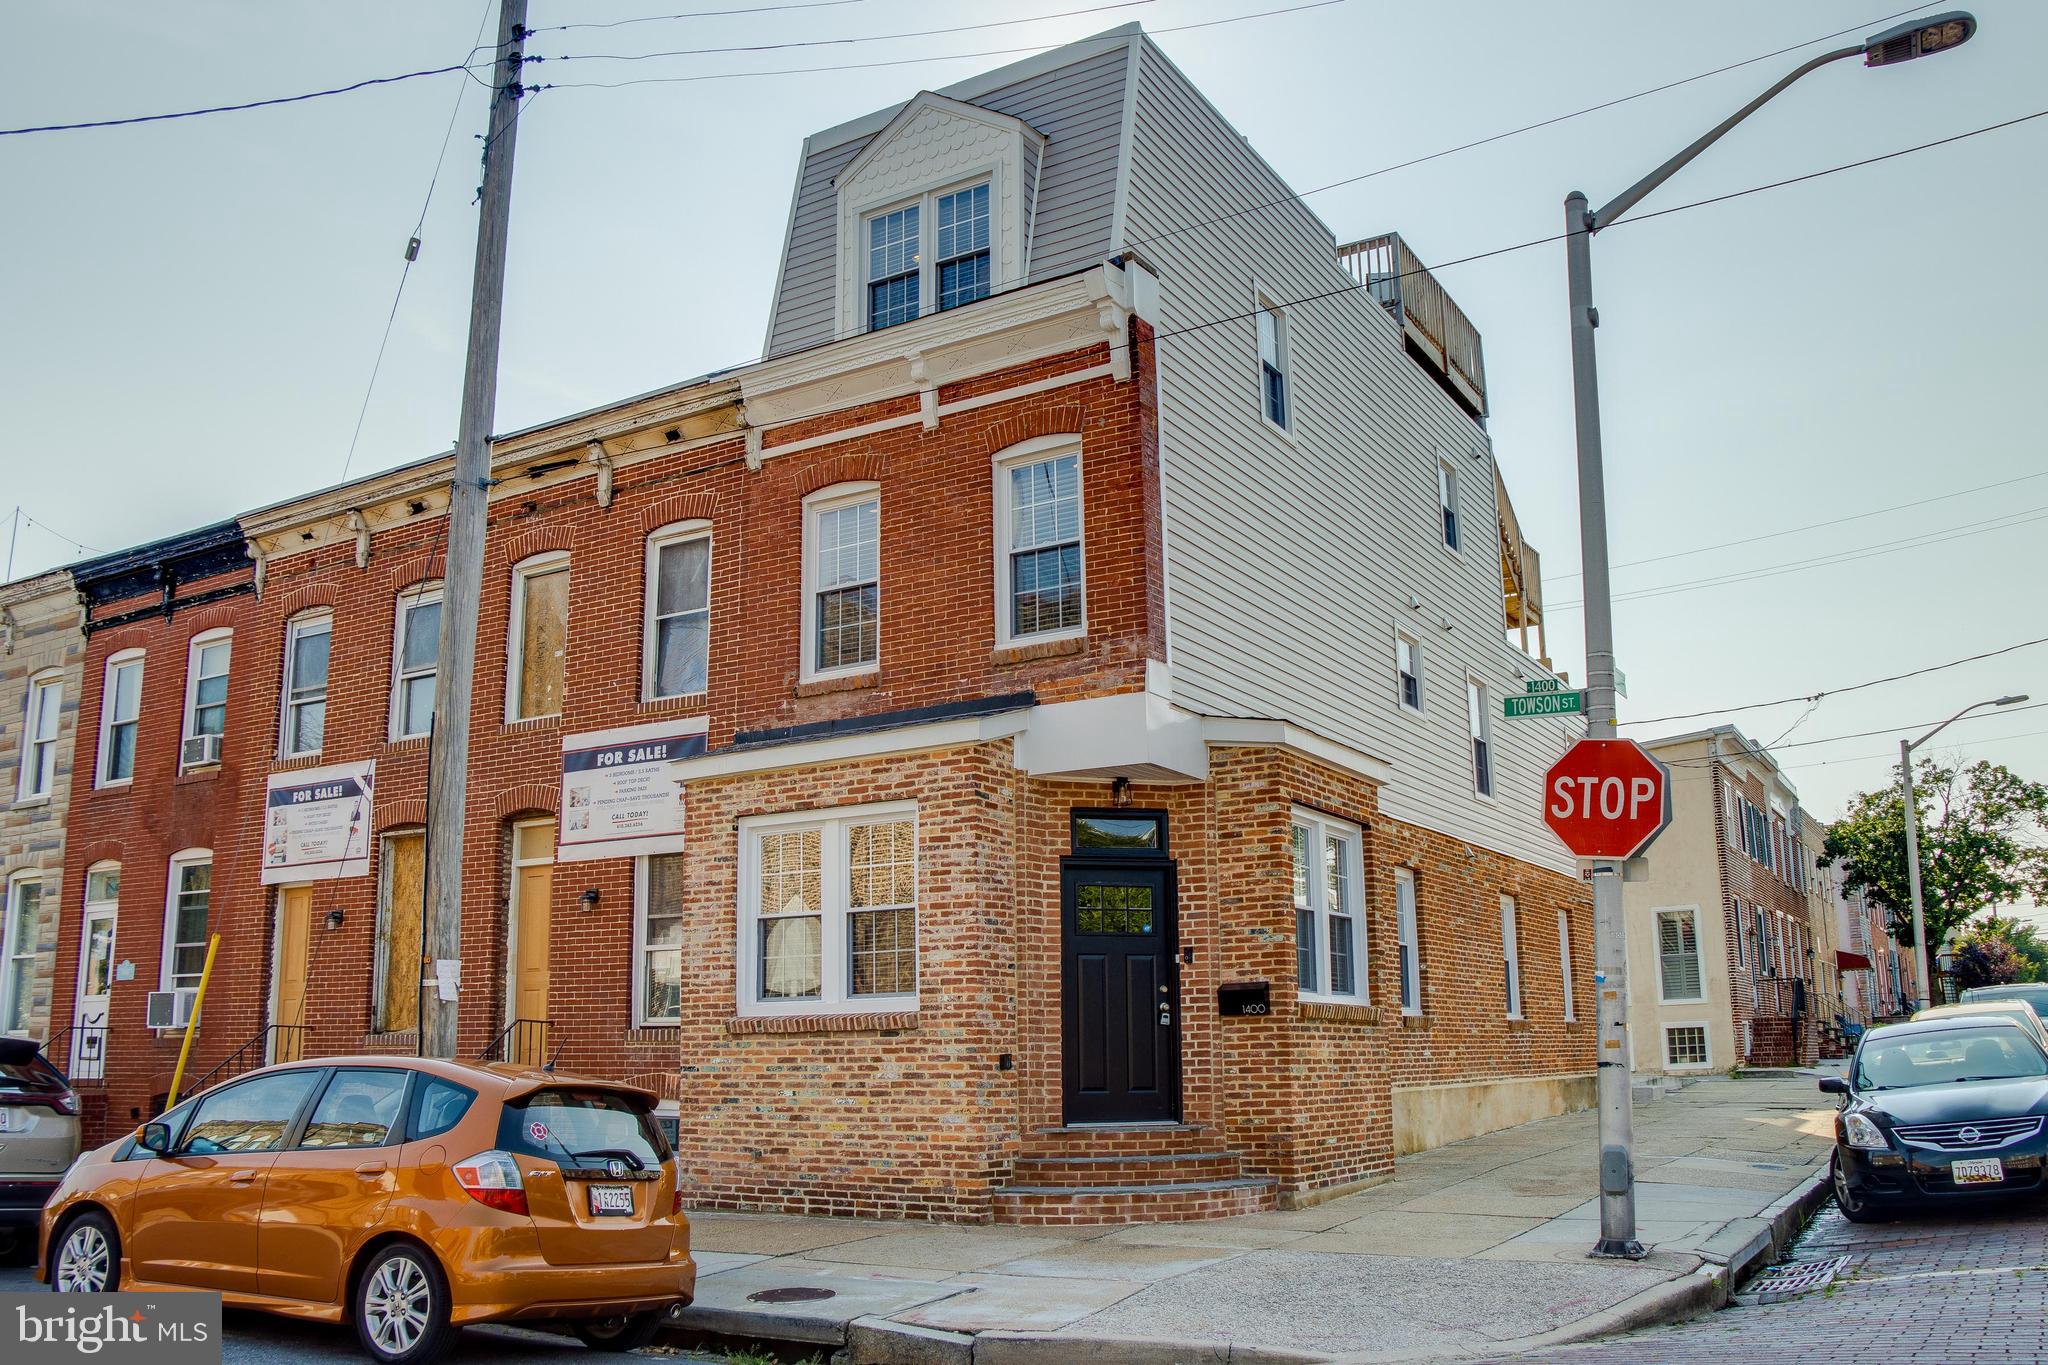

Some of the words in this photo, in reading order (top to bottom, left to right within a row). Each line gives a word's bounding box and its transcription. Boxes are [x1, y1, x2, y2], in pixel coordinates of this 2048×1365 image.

[1531, 680, 1555, 693] 1400
[1512, 695, 1561, 715] TOWSON
[1561, 697, 1576, 709] ST.
[597, 750, 623, 767] FOR
[627, 744, 667, 763] SALE!
[292, 790, 312, 803] FOR
[314, 785, 343, 800] SALE!
[1551, 776, 1655, 820] STOP
[627, 810, 649, 819] TODAY!
[1242, 1003, 1266, 1014] 1400
